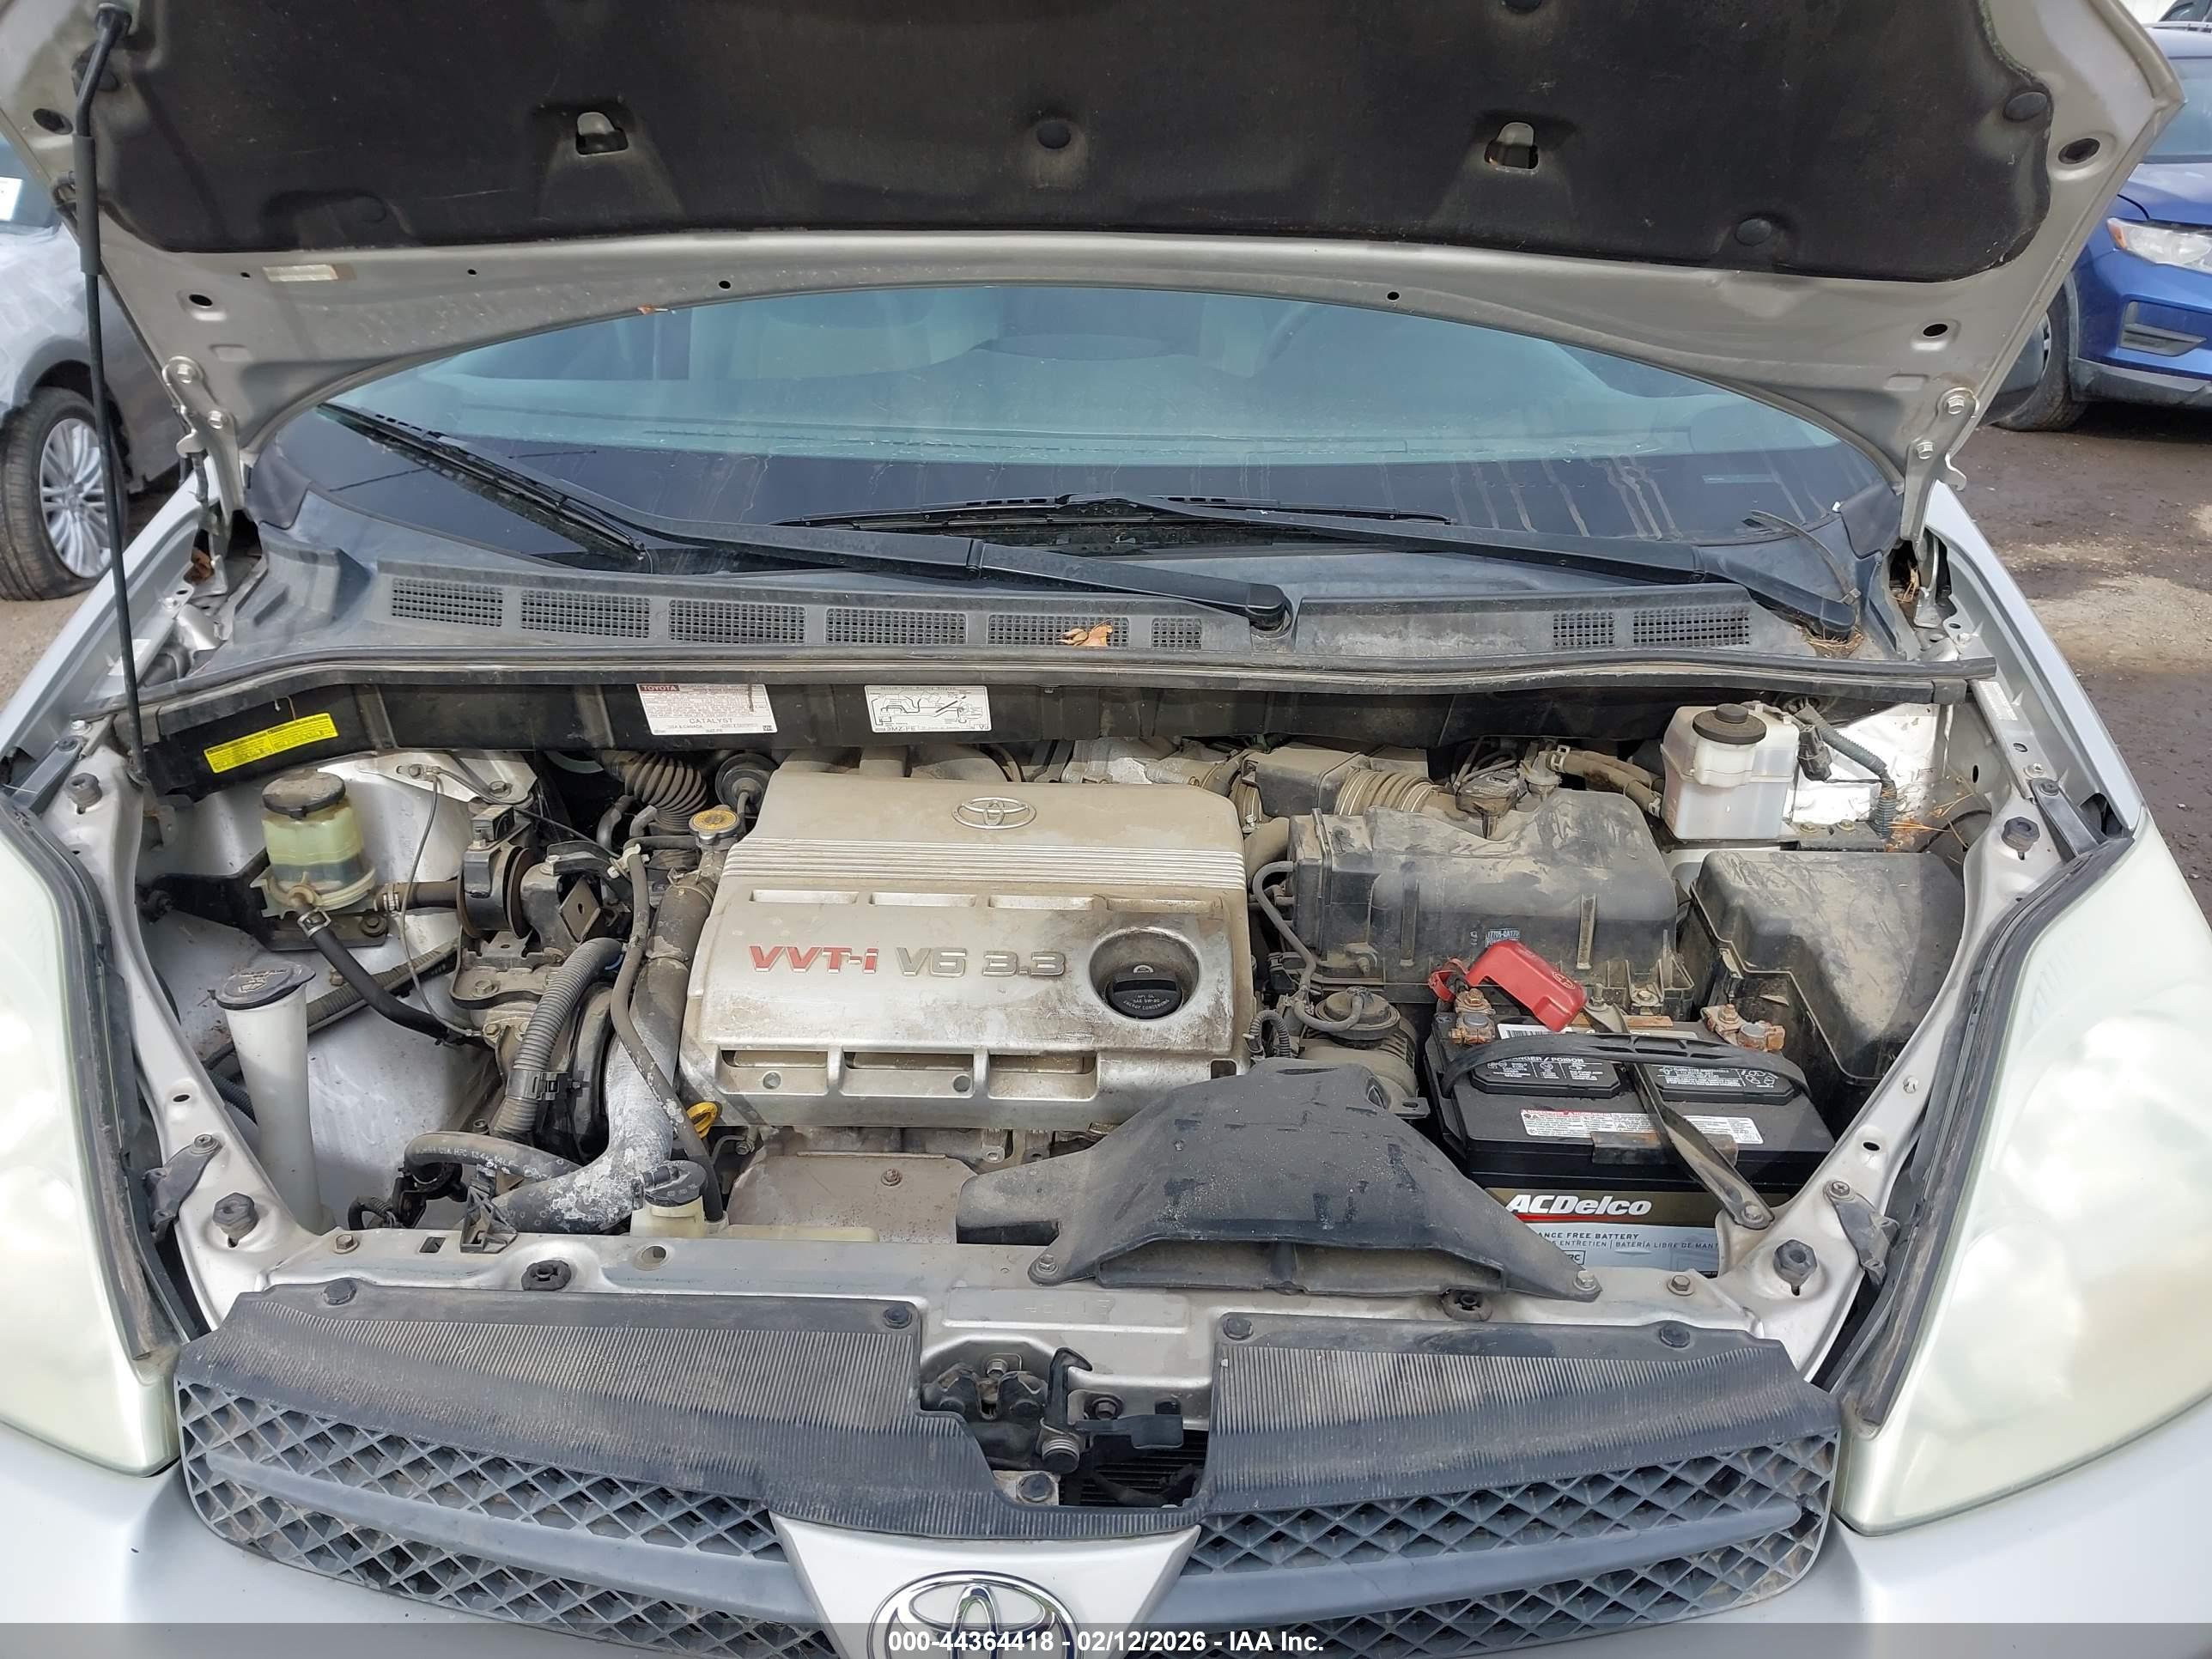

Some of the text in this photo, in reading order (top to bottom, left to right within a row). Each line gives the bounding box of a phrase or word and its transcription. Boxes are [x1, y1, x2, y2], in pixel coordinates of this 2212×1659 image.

[750, 945, 1066, 977] VVT-i V6 3.3
[1505, 1195, 1651, 1215] ACDelco
